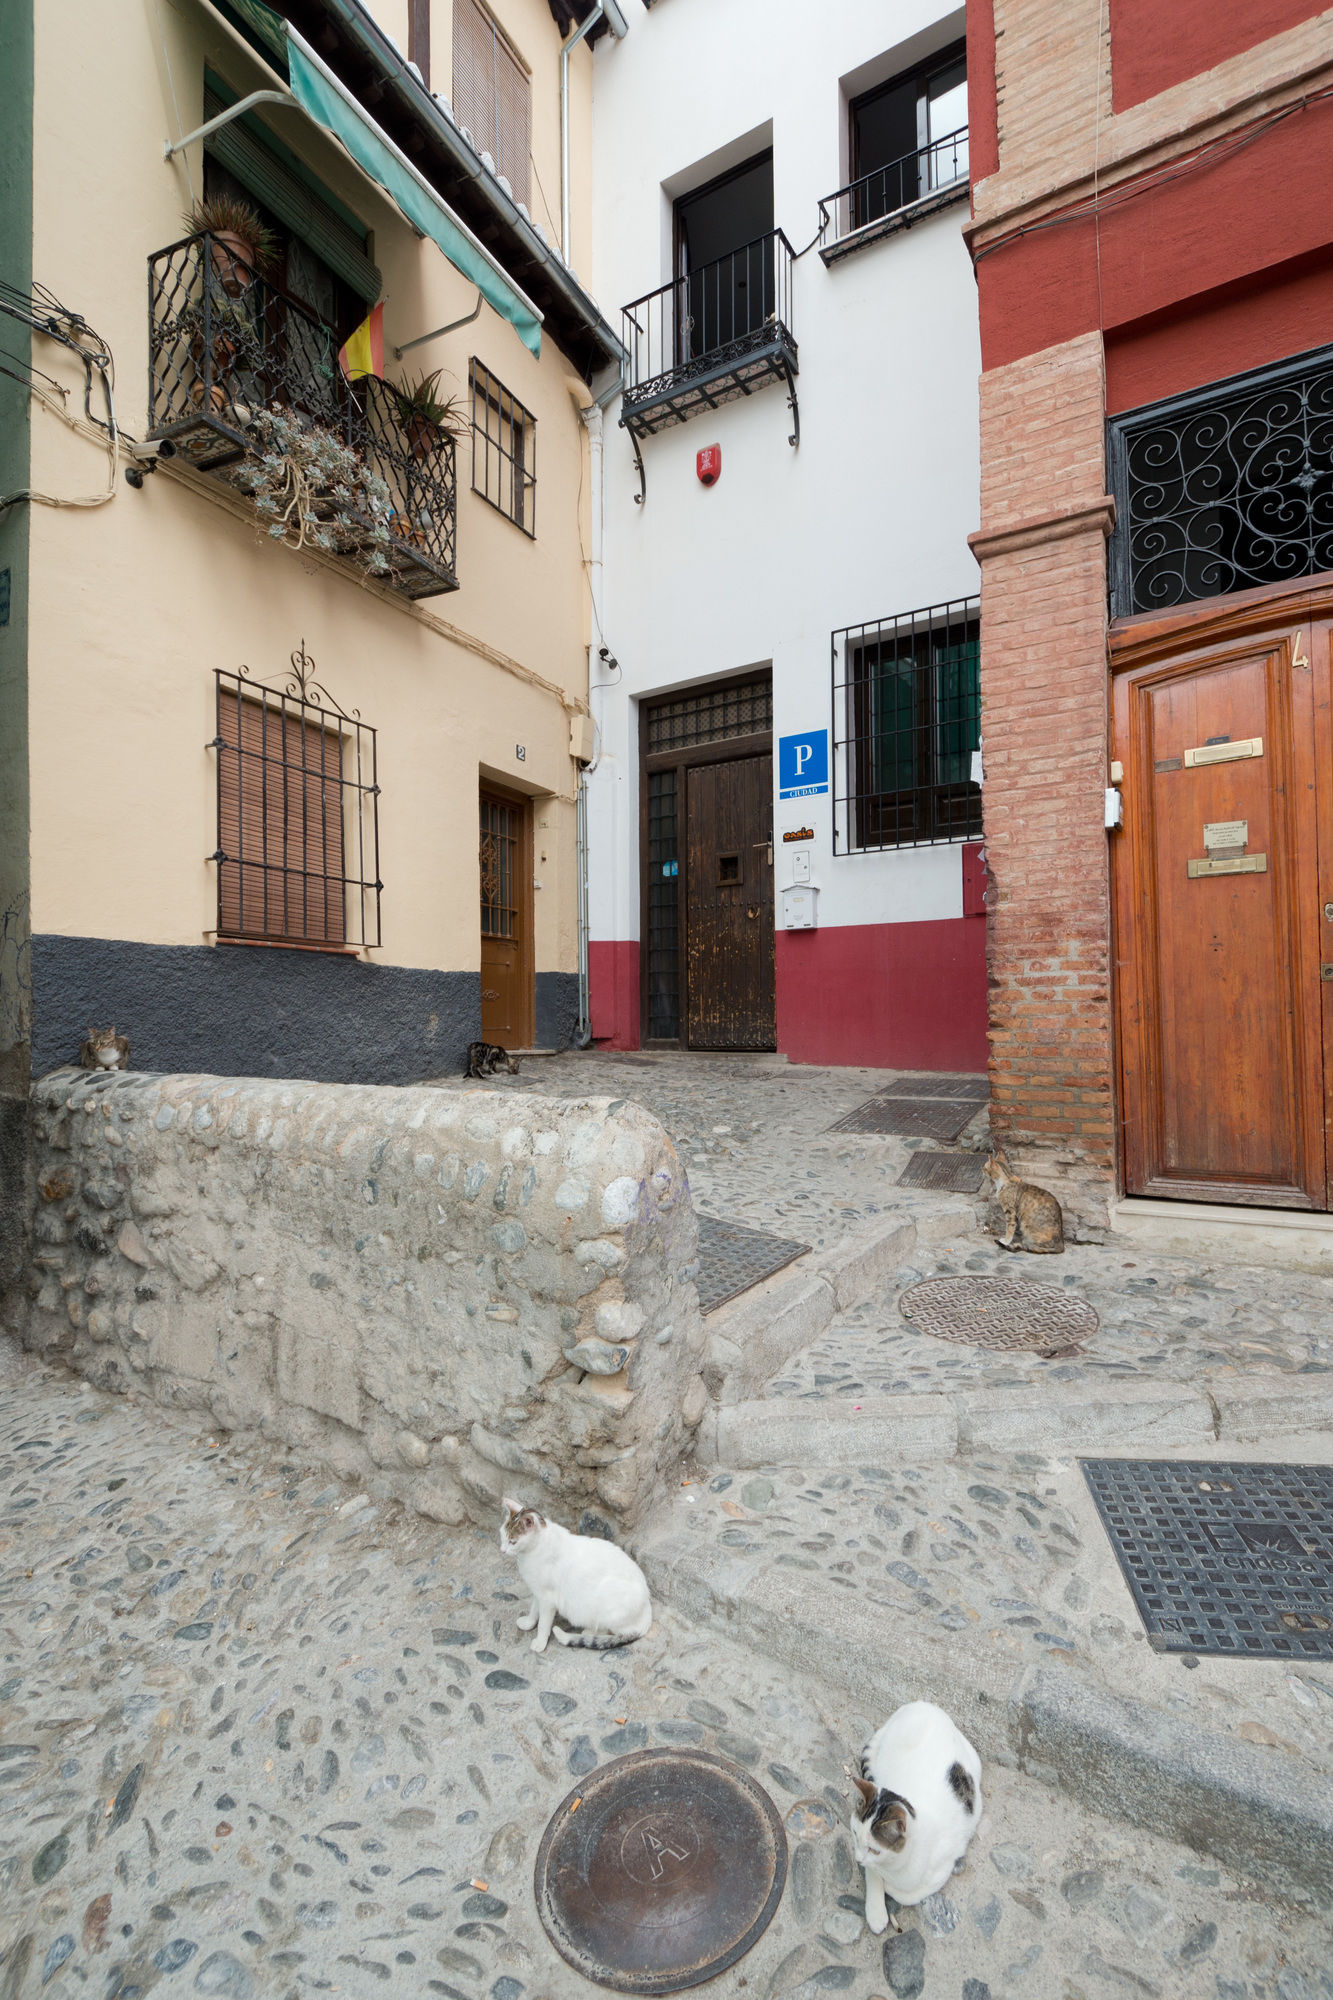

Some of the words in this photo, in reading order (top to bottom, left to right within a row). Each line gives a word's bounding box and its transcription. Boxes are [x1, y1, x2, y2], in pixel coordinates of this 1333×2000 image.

[1292, 631, 1308, 668] 4
[518, 746, 525, 760] 2
[793, 744, 813, 776] P
[790, 787, 818, 798] CIUDAD
[1221, 1556, 1318, 1573] endesa
[640, 1826, 690, 1881] A
